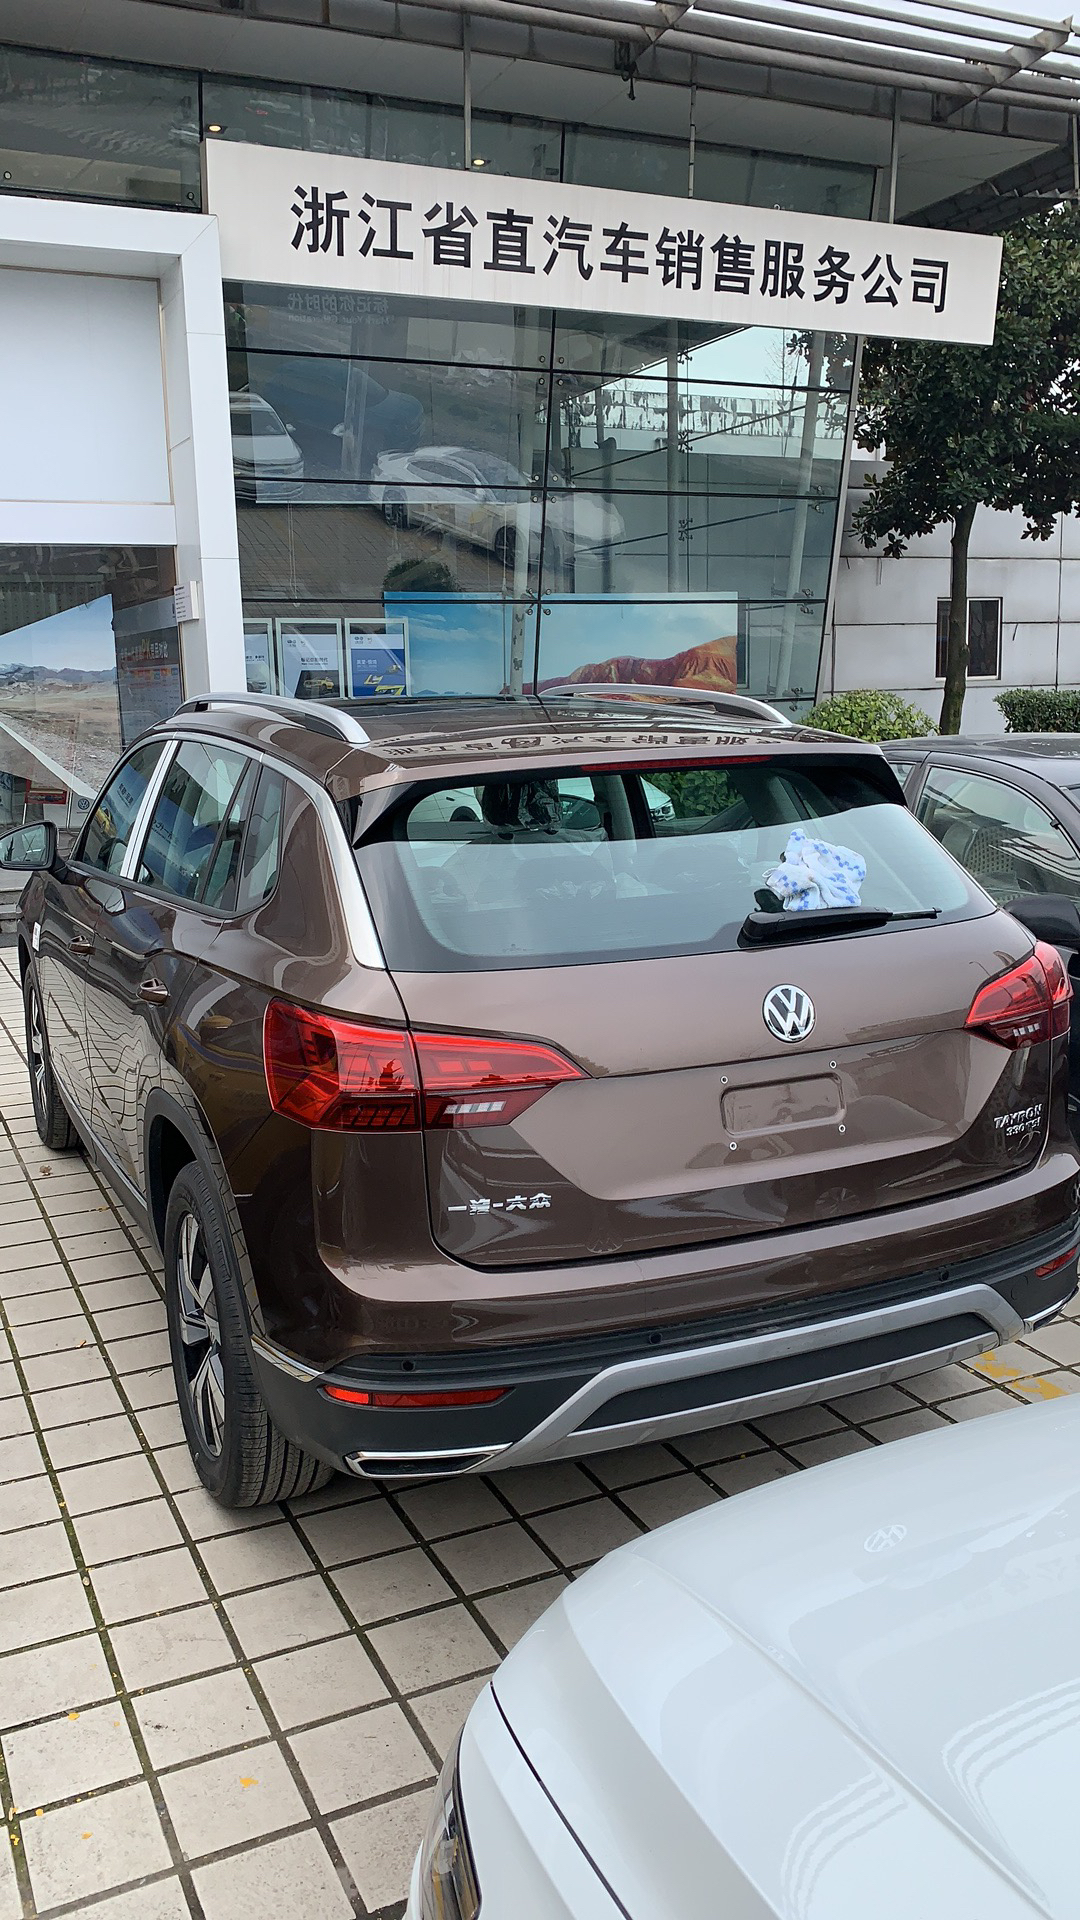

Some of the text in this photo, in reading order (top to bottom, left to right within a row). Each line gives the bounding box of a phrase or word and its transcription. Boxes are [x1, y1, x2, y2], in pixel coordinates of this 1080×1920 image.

[290, 185, 951, 313] 浙江省直汽车销售服务公司
[994, 1103, 1042, 1128] TAYRON
